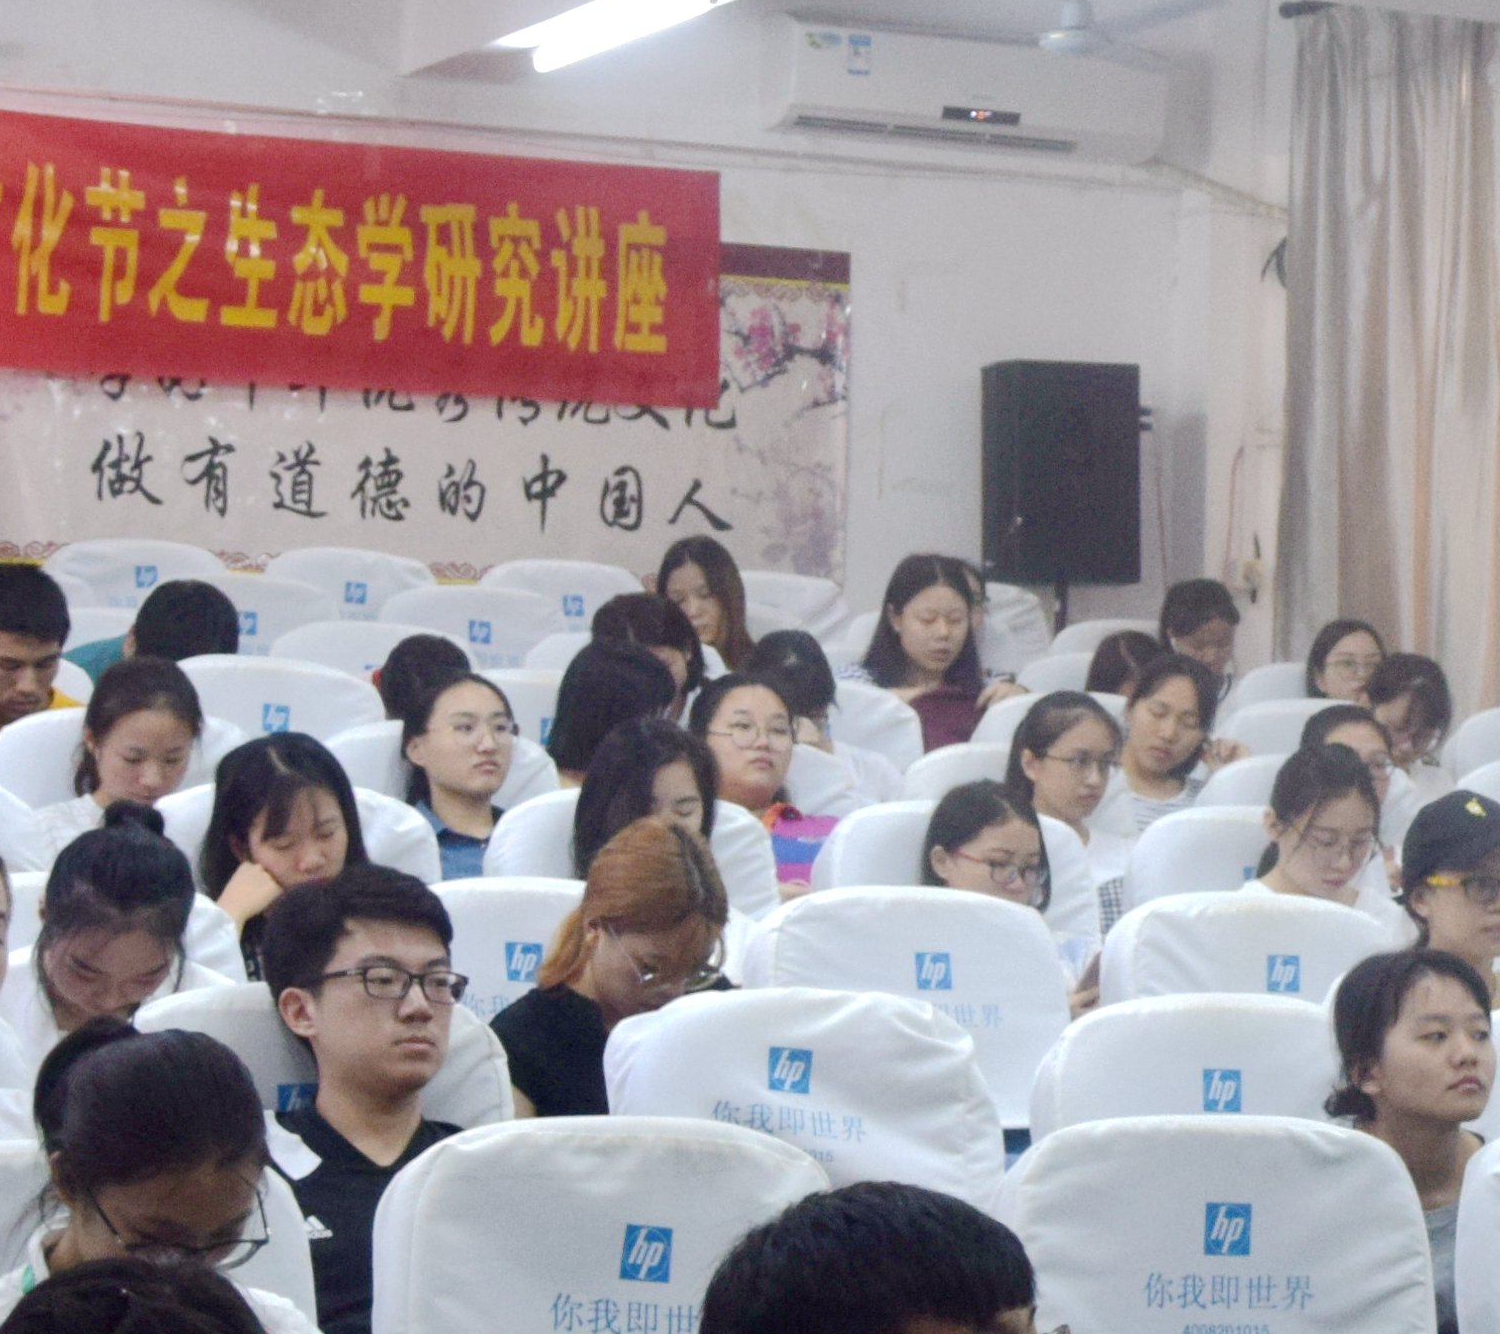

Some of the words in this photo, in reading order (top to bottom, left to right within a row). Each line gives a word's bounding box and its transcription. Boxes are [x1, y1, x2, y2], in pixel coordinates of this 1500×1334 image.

[91, 430, 735, 534] 做有道德的中国人
[509, 943, 537, 981] hp
[919, 954, 948, 989] hp
[1271, 956, 1296, 991] hp
[773, 1049, 808, 1093] hp
[1208, 1071, 1237, 1111] hp
[711, 1100, 867, 1143] 你我即世界
[1210, 1204, 1246, 1256] hp
[626, 1225, 667, 1282] hp
[1145, 1272, 1314, 1312] 你我即世界
